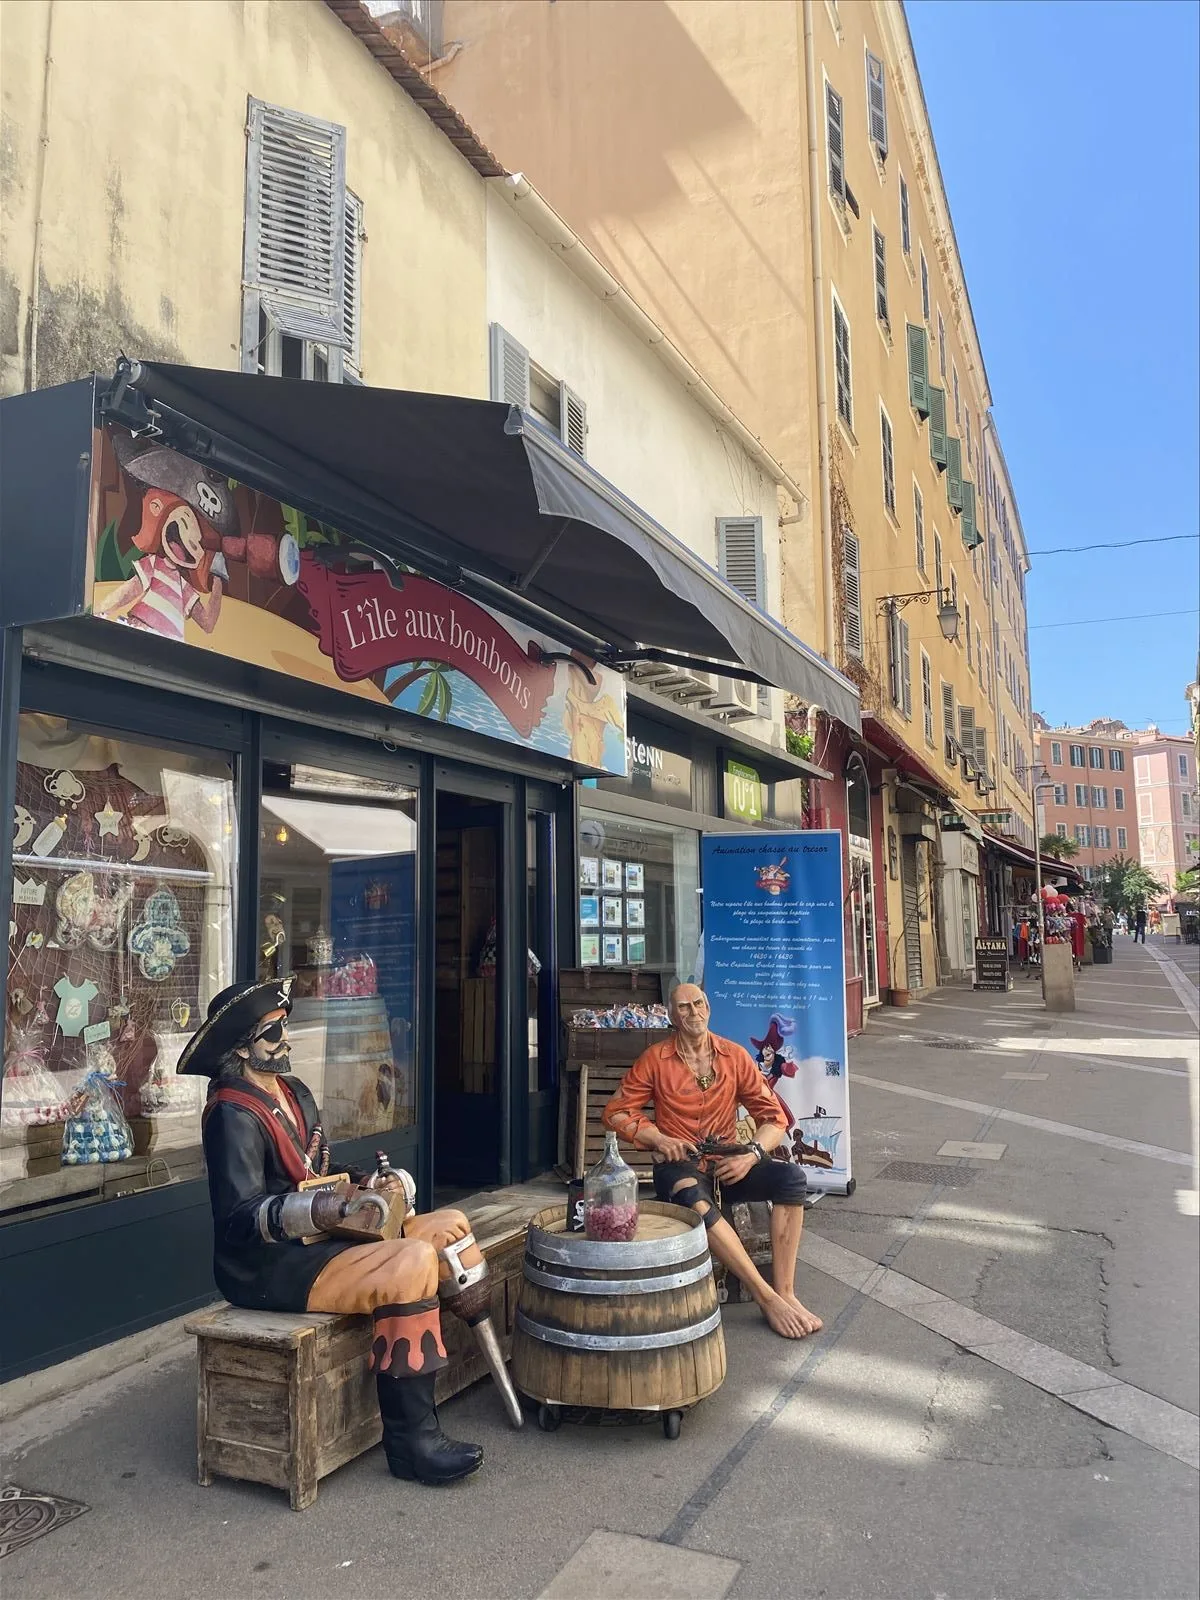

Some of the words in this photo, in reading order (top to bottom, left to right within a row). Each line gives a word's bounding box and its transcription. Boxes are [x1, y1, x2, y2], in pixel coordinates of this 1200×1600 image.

[341, 597, 399, 650] L'île
[405, 609, 447, 643] aux
[449, 609, 532, 710] bonbons
[712, 845, 755, 855] Animation
[758, 843, 786, 854] chasse
[976, 939, 1007, 950] ALTANA
